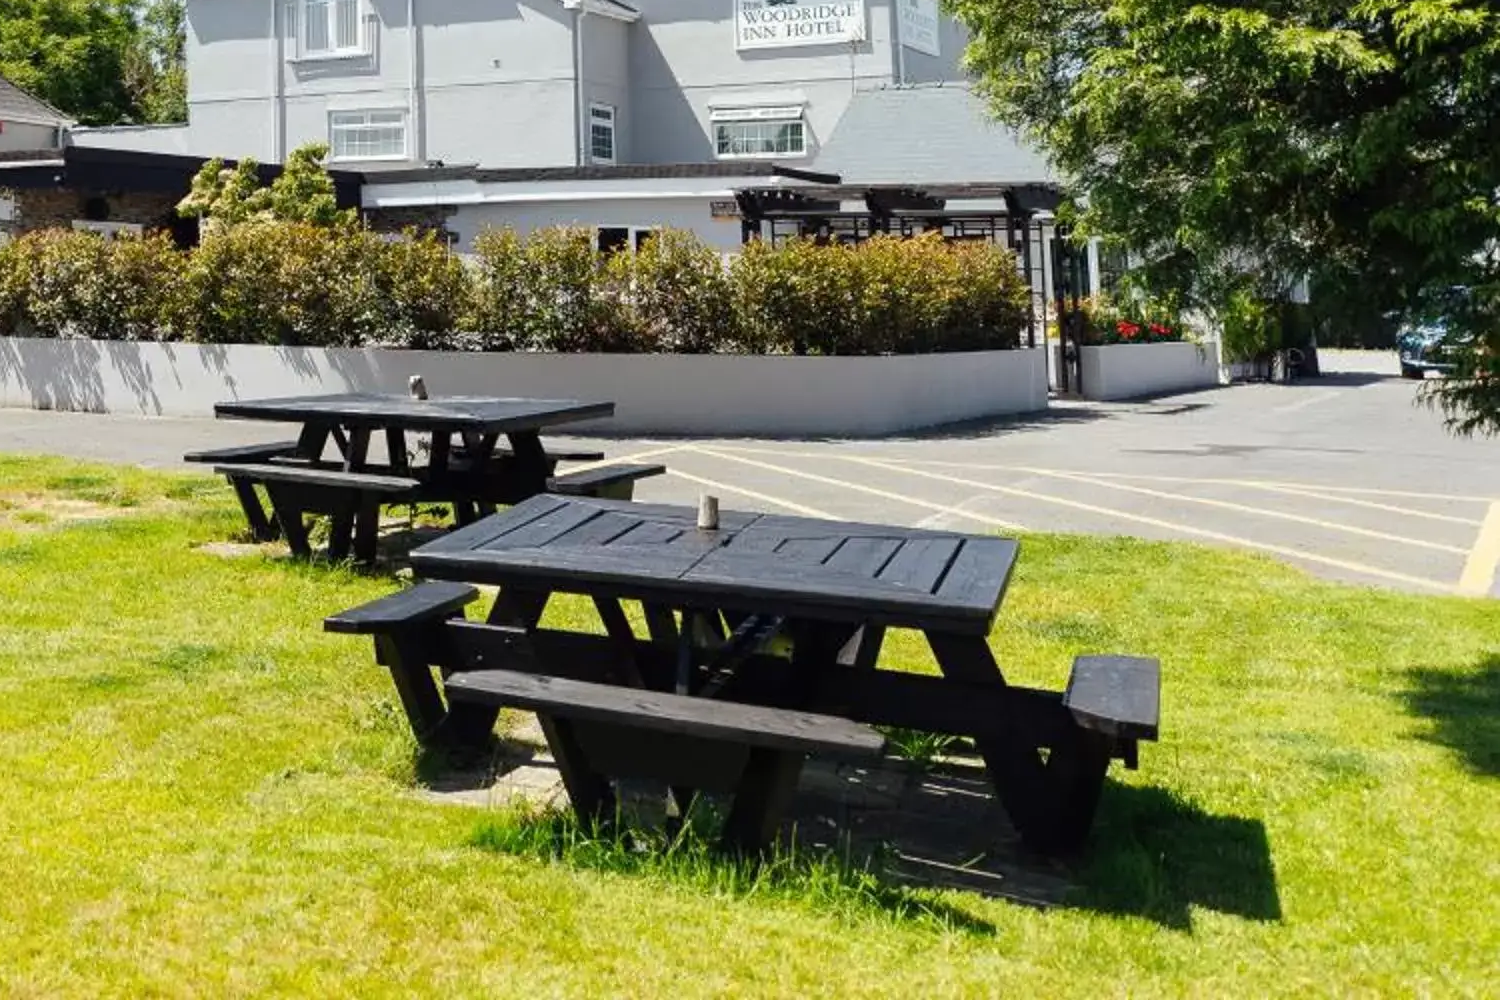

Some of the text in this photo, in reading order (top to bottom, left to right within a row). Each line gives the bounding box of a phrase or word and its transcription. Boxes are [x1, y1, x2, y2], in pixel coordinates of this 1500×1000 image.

[743, 2, 855, 24] WOODRIDGE
[743, 20, 844, 40] INN HOTEL
